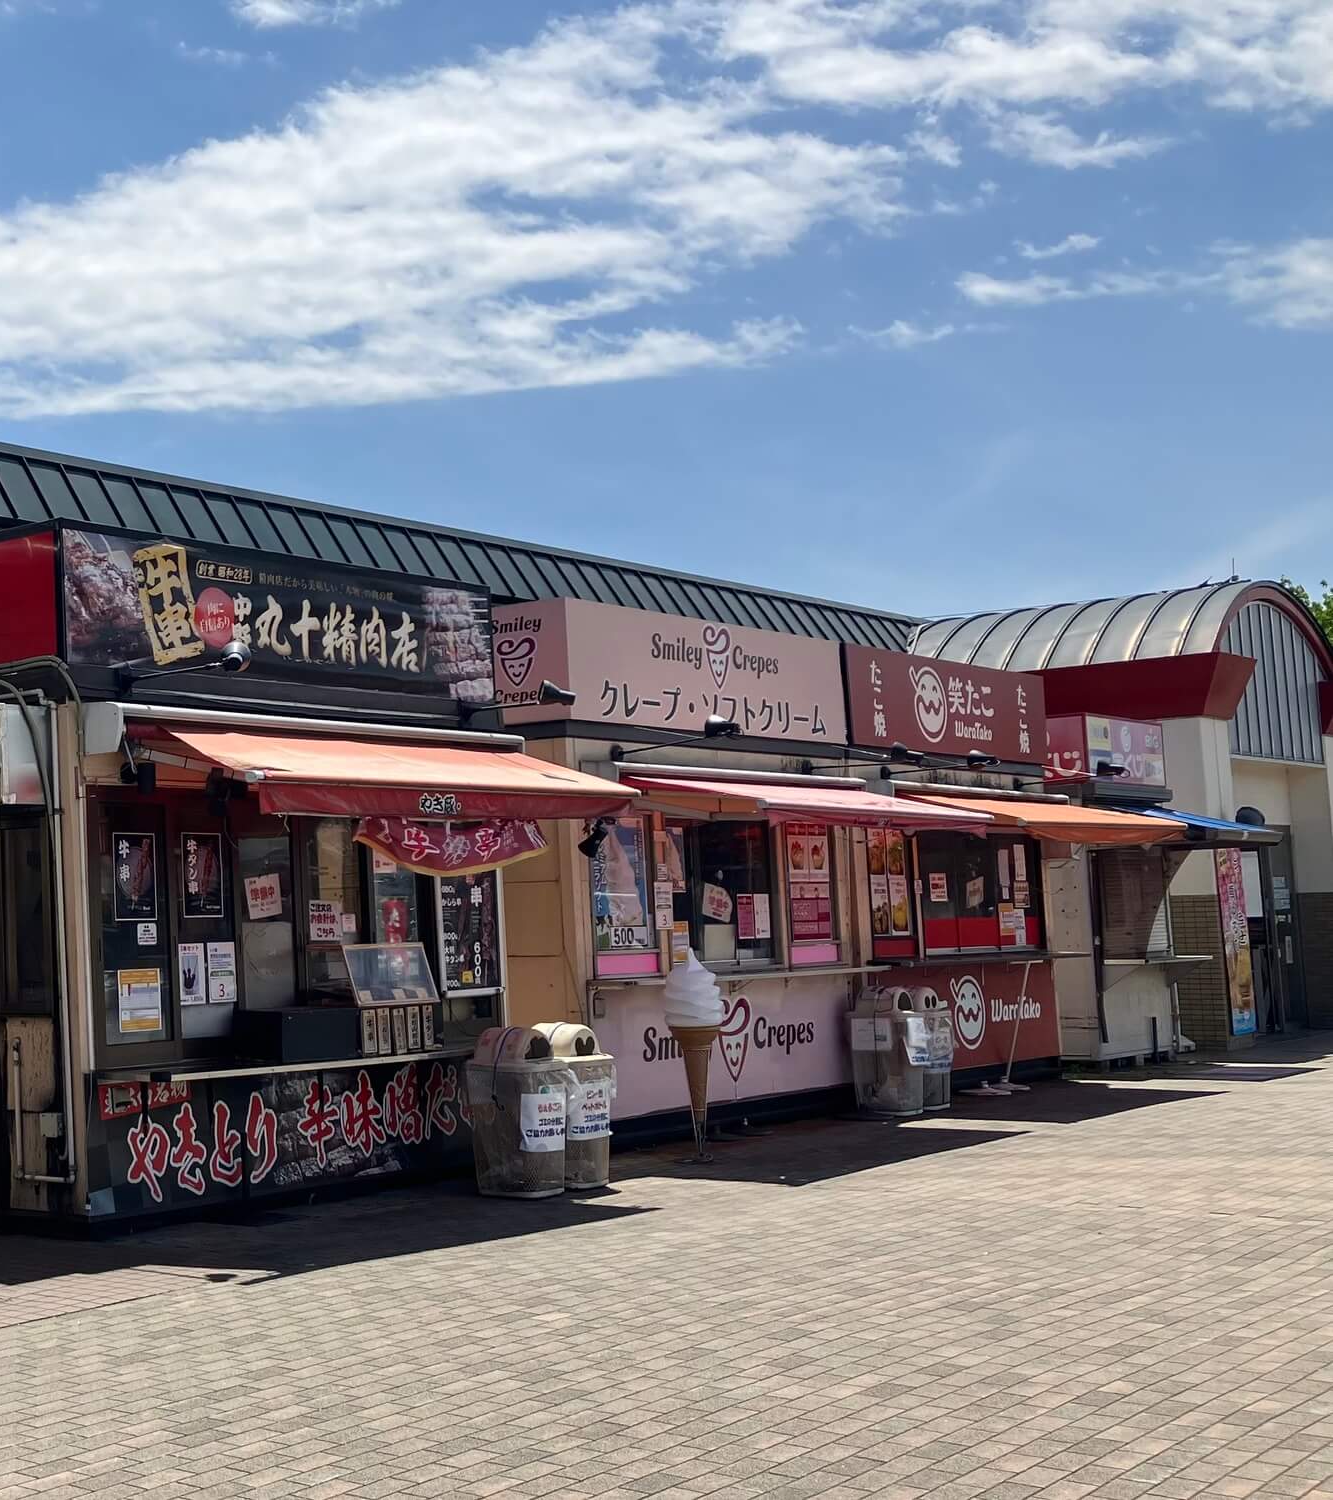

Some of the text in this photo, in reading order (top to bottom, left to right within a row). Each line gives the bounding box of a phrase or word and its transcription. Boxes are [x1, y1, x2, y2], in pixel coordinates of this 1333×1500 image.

[255, 594, 421, 673] 丸十精肉店
[492, 616, 542, 635] Smiley
[651, 633, 779, 680] Smiley Crepes
[495, 689, 538, 704] Crepe
[600, 680, 827, 737] クレープ・ソフトクリーム
[869, 660, 887, 737] たこ焼
[948, 676, 995, 718] 笑たこ
[1016, 684, 1030, 754] たこ焼
[118, 839, 131, 882] 牛串
[186, 839, 199, 895] 牛タン串
[317, 927, 335, 938] こちら
[614, 928, 634, 945] 500
[754, 1016, 814, 1055] Crepes
[127, 1091, 278, 1202] やきとり
